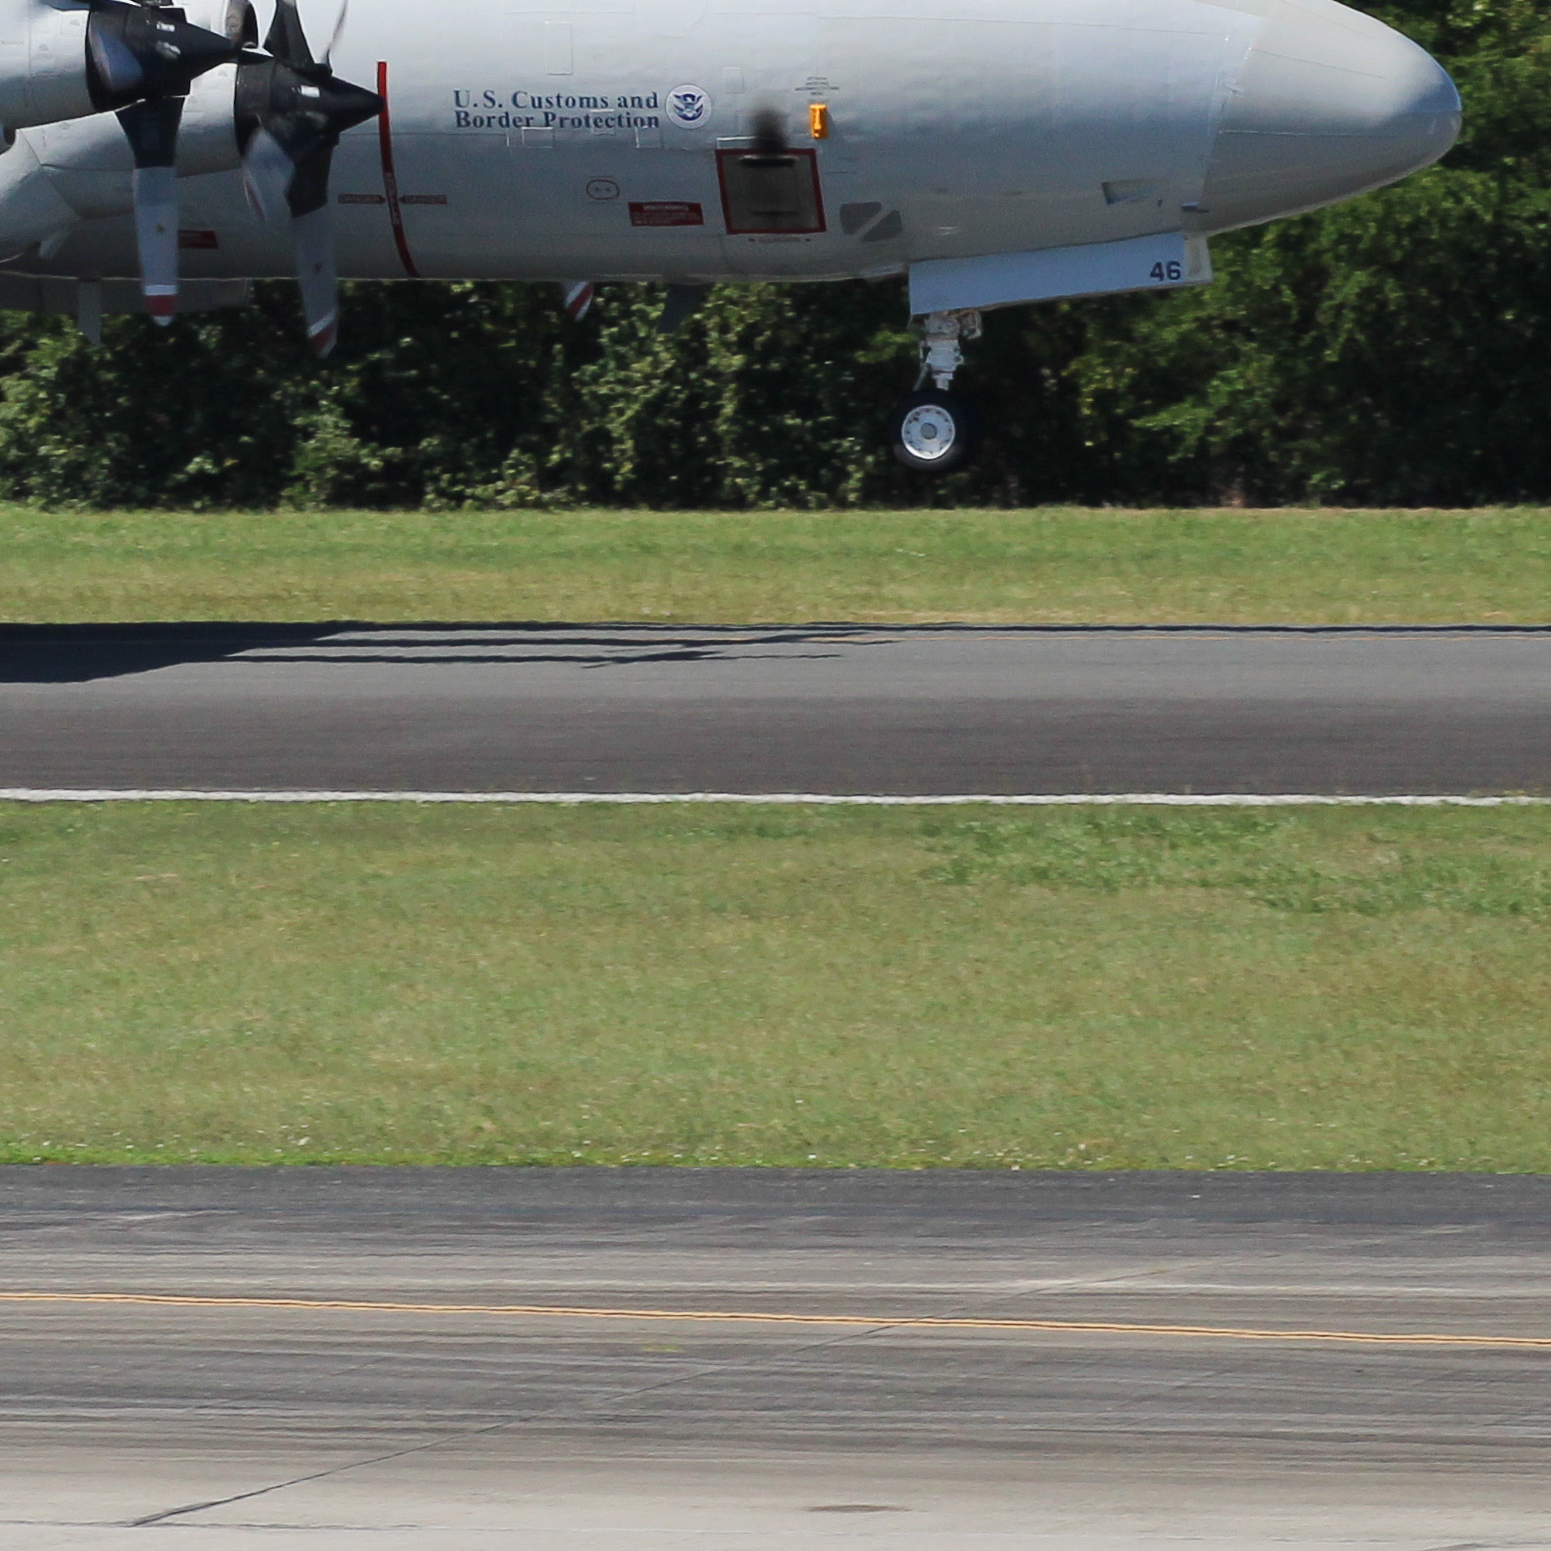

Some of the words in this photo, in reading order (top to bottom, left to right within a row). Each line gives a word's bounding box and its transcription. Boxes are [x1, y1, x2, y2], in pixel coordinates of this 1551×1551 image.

[511, 89, 609, 109] Customs
[617, 90, 659, 109] and
[455, 110, 534, 129] Border
[544, 110, 660, 129] Protection
[1150, 261, 1182, 282] 46
